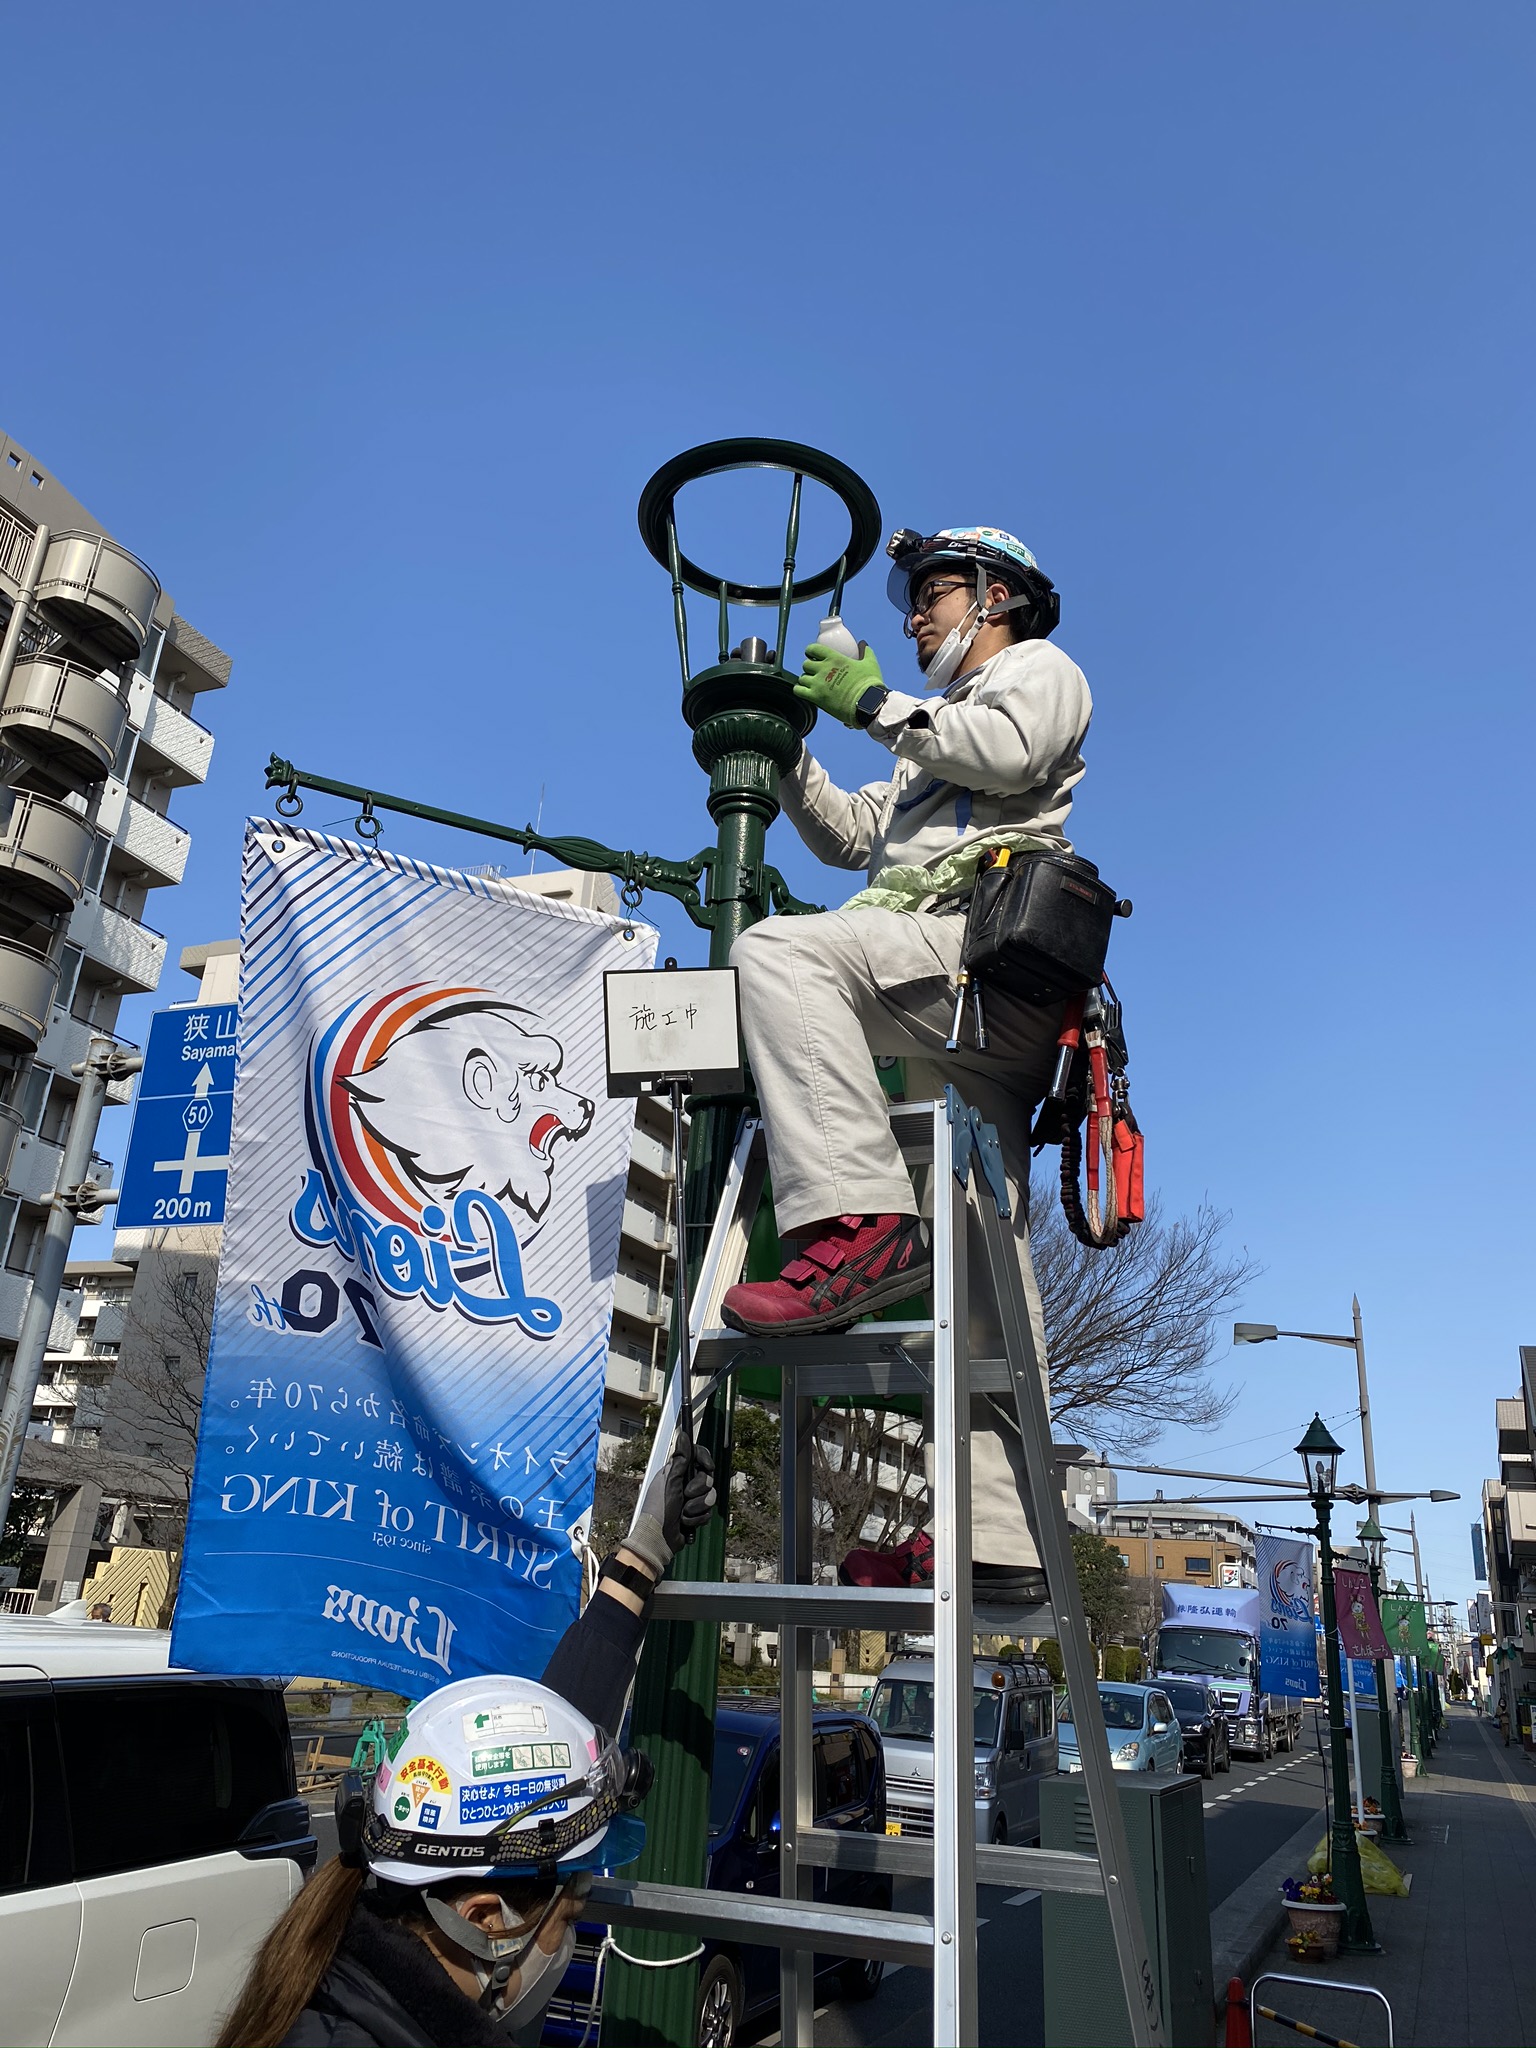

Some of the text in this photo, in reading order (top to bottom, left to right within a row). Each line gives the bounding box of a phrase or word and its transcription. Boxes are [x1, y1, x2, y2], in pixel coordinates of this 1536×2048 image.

[183, 1010, 236, 1042] 狭山
[629, 1003, 697, 1030] 施工中
[181, 1043, 235, 1062] Sayama
[187, 1105, 208, 1125] 50
[414, 1843, 486, 1858] GENTOS
